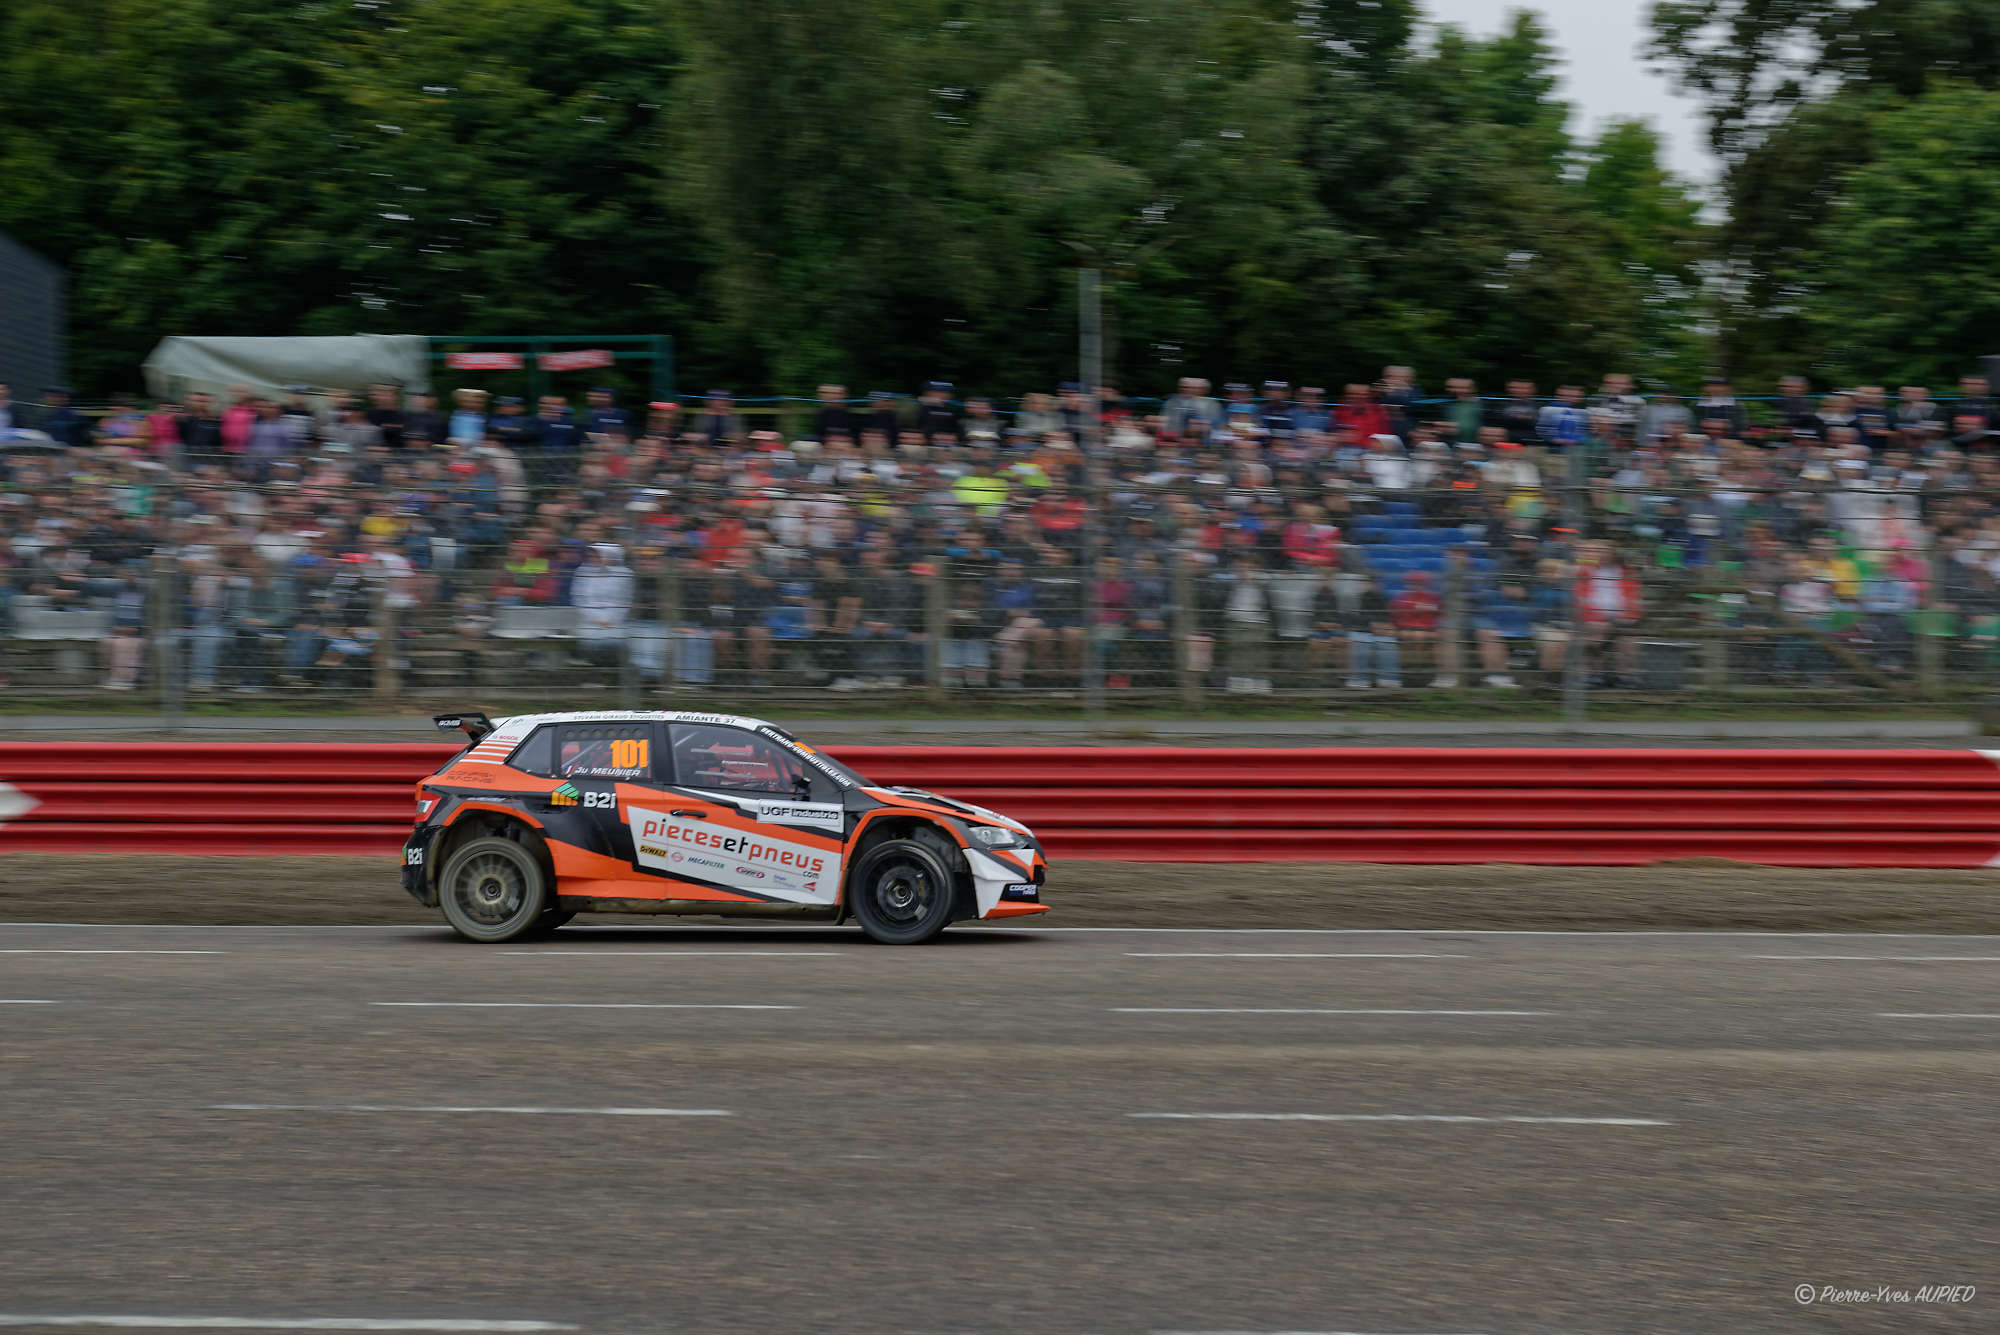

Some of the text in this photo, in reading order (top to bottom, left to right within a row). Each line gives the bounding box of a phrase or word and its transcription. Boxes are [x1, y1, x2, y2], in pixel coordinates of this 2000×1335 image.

[675, 714, 720, 723] AMIANTE
[609, 739, 648, 768] 101
[590, 767, 641, 777] MEUNIER
[583, 791, 616, 809] B2i
[761, 806, 790, 816] UGF
[642, 818, 824, 872] piecesetpneus
